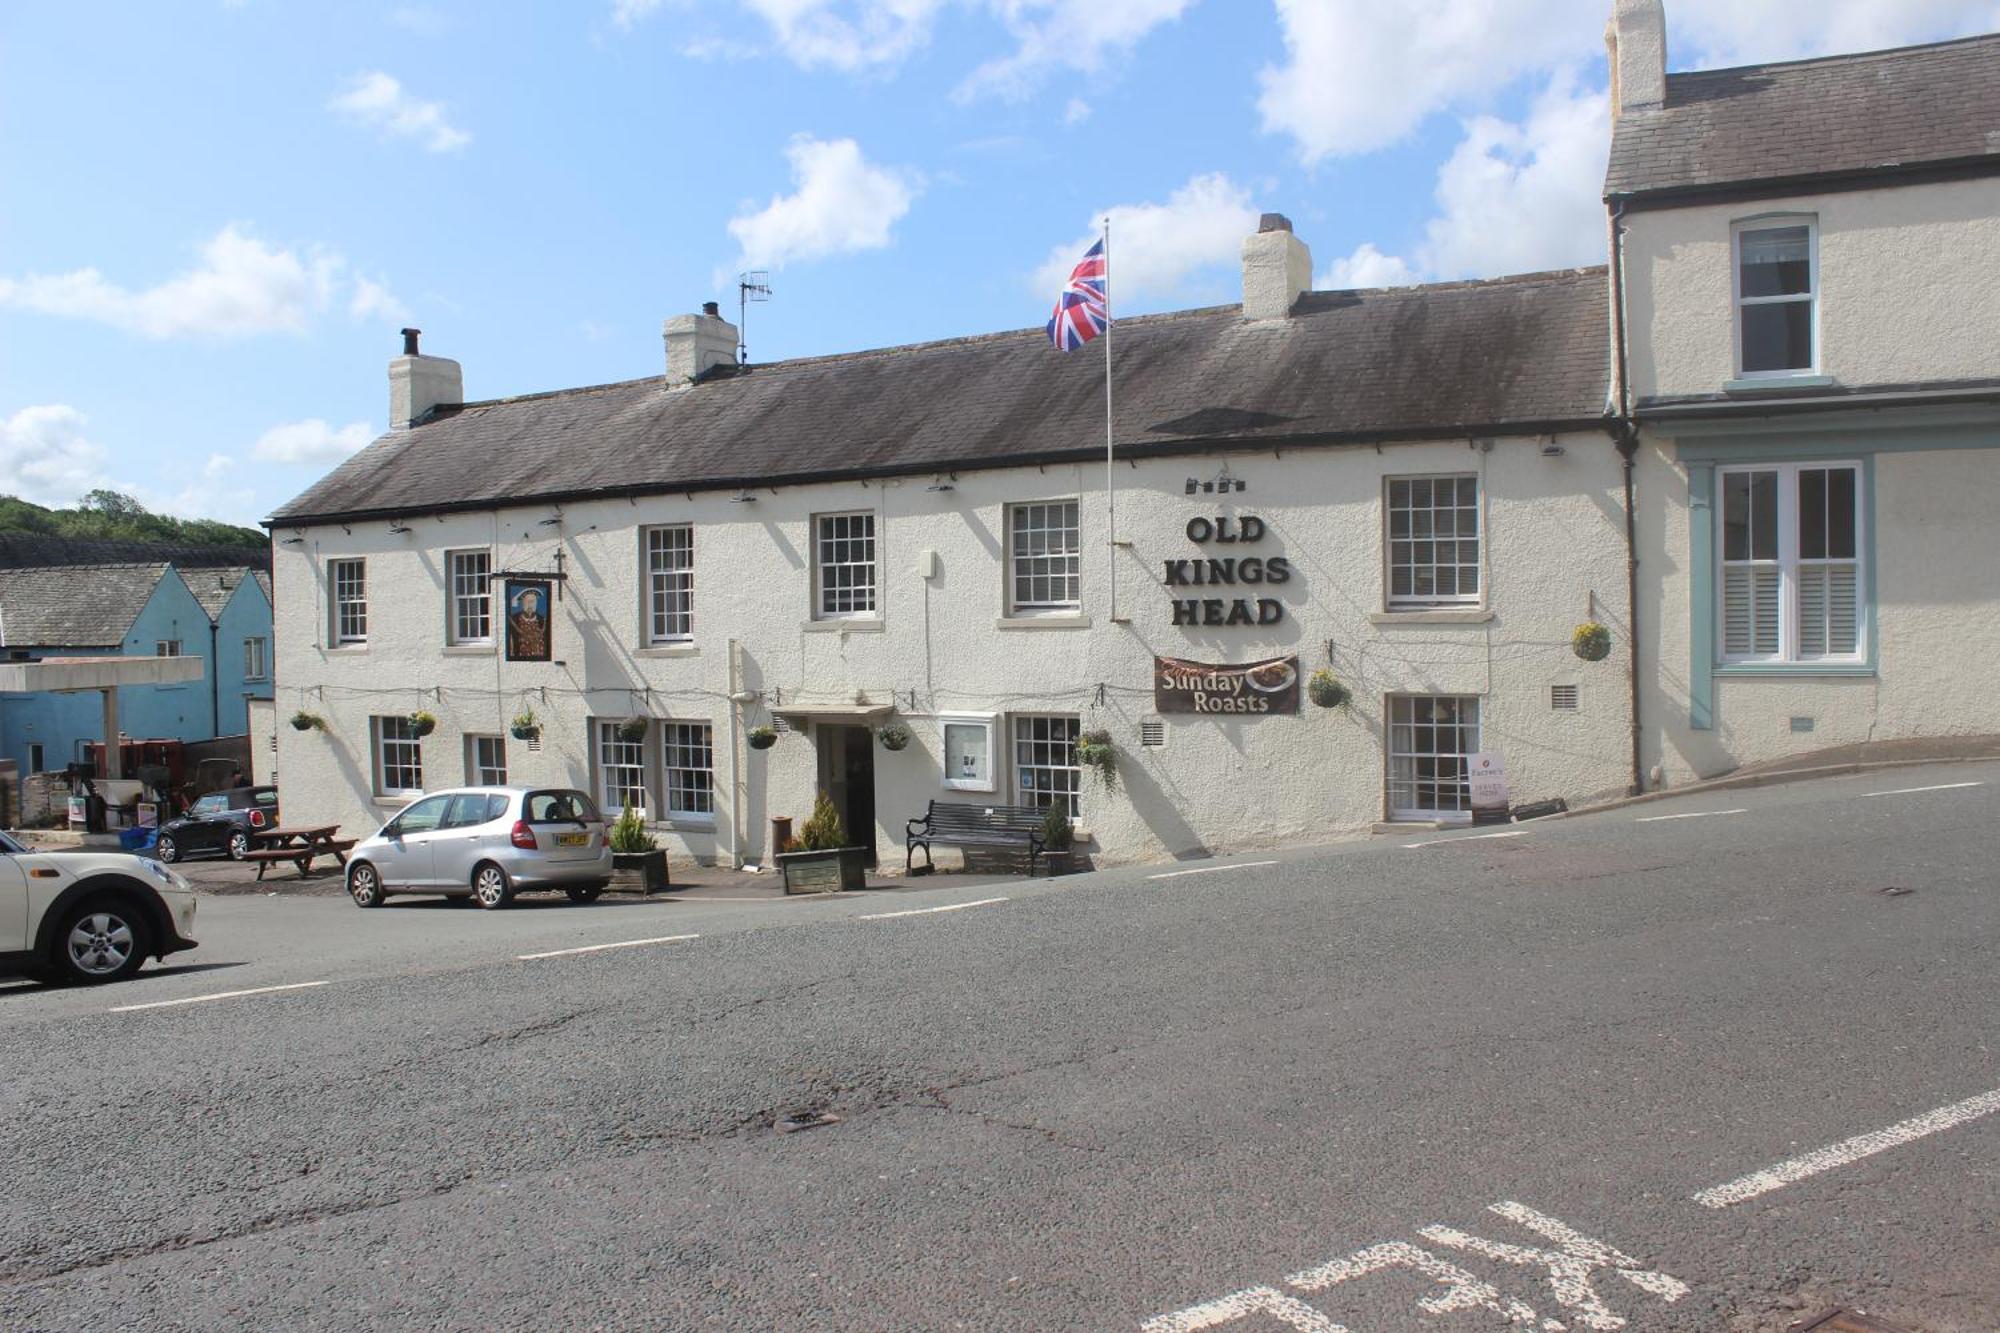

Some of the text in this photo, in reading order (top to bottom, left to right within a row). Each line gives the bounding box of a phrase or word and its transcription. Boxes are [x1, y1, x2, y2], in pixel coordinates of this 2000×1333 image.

[1186, 516, 1265, 543] OLD
[1164, 557, 1290, 585] KINGS
[1171, 599, 1283, 626] HEAD
[1162, 671, 1244, 696] Sunday
[1194, 691, 1269, 713] Roasts
